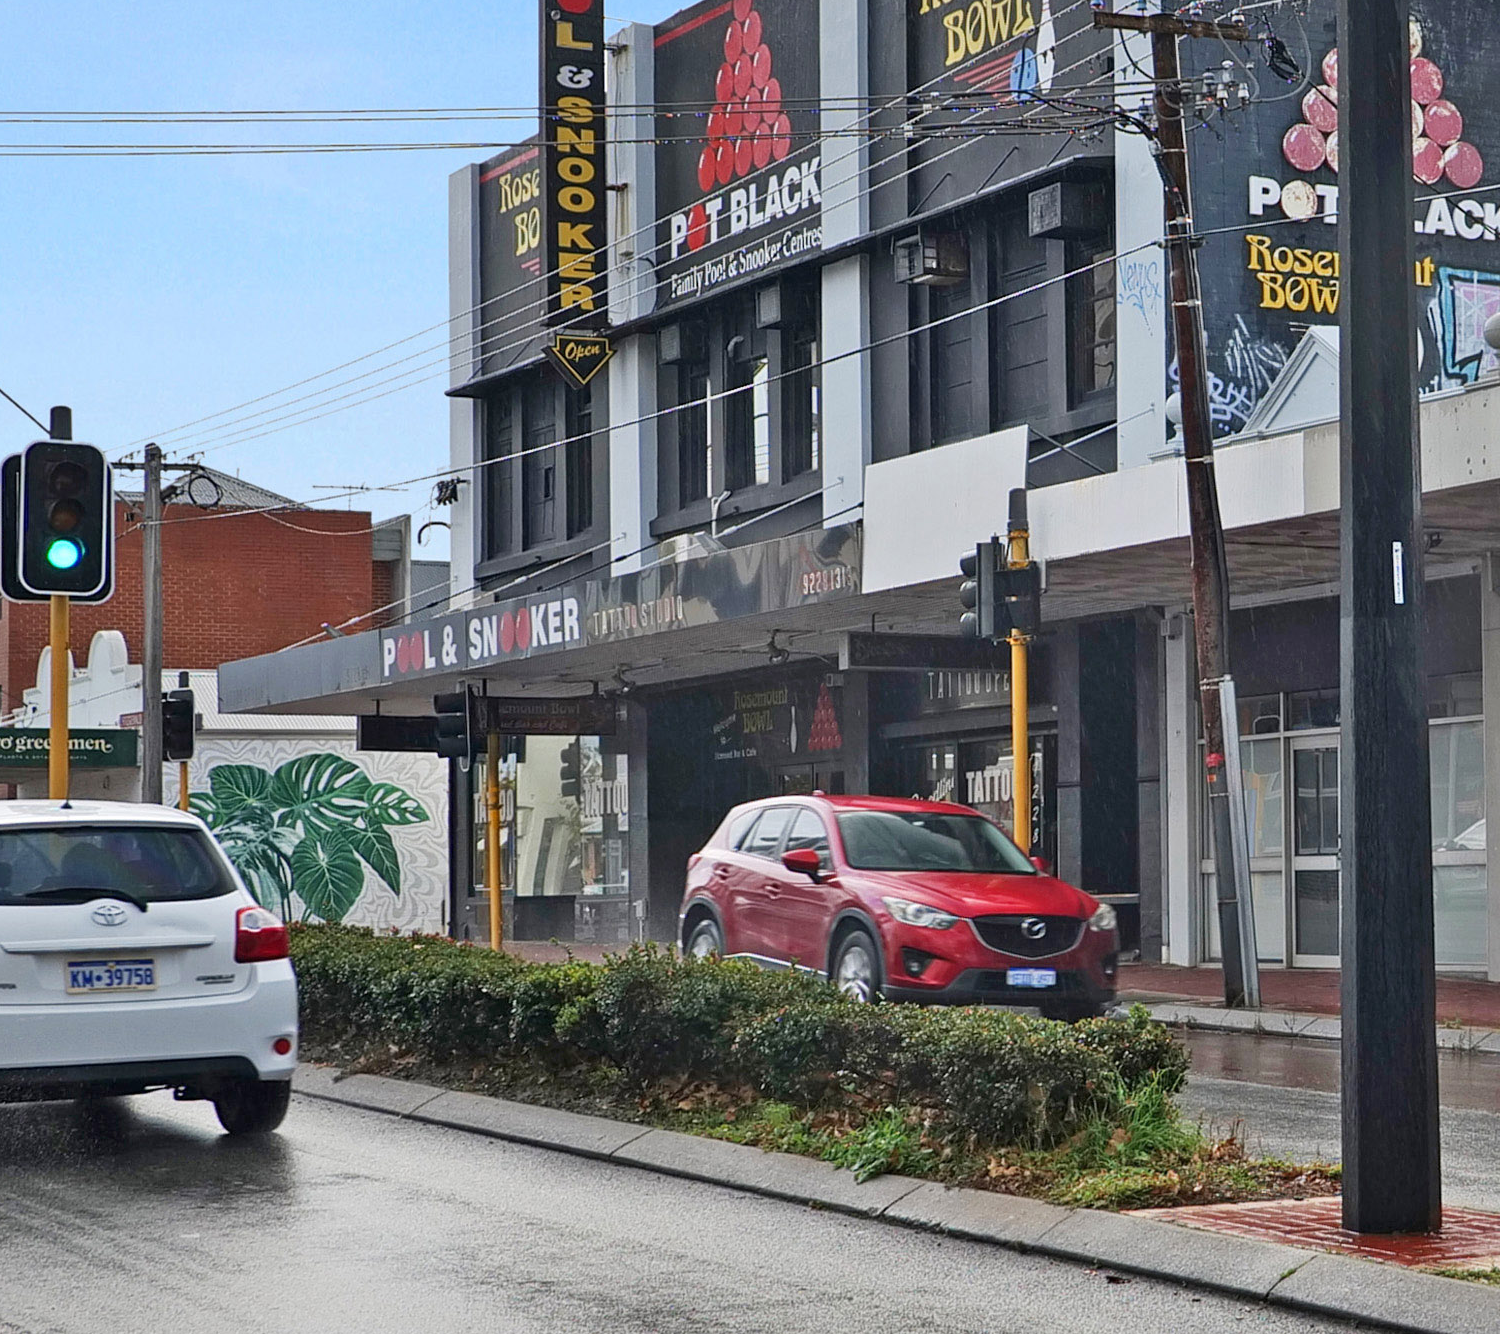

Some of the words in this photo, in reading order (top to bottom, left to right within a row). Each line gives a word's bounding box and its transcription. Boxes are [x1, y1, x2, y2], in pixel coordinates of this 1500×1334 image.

[556, 65, 594, 89] &
[556, 96, 596, 311] SNOOKER
[730, 156, 822, 235] BLACK
[671, 266, 703, 298] Family
[704, 257, 726, 286] Pool
[728, 254, 738, 276] &
[739, 240, 782, 274] Snooker
[783, 227, 822, 257] Centres
[1256, 272, 1339, 314] BOW
[564, 341, 600, 361] Open
[441, 625, 458, 665] &
[469, 597, 581, 661] SNOOKER
[593, 605, 638, 636] TATTOO
[641, 595, 684, 627] STUDIO
[733, 686, 788, 710] Rosemount
[742, 709, 773, 733] BOWL
[15, 736, 51, 753] gree
[966, 769, 1014, 803] TATTO
